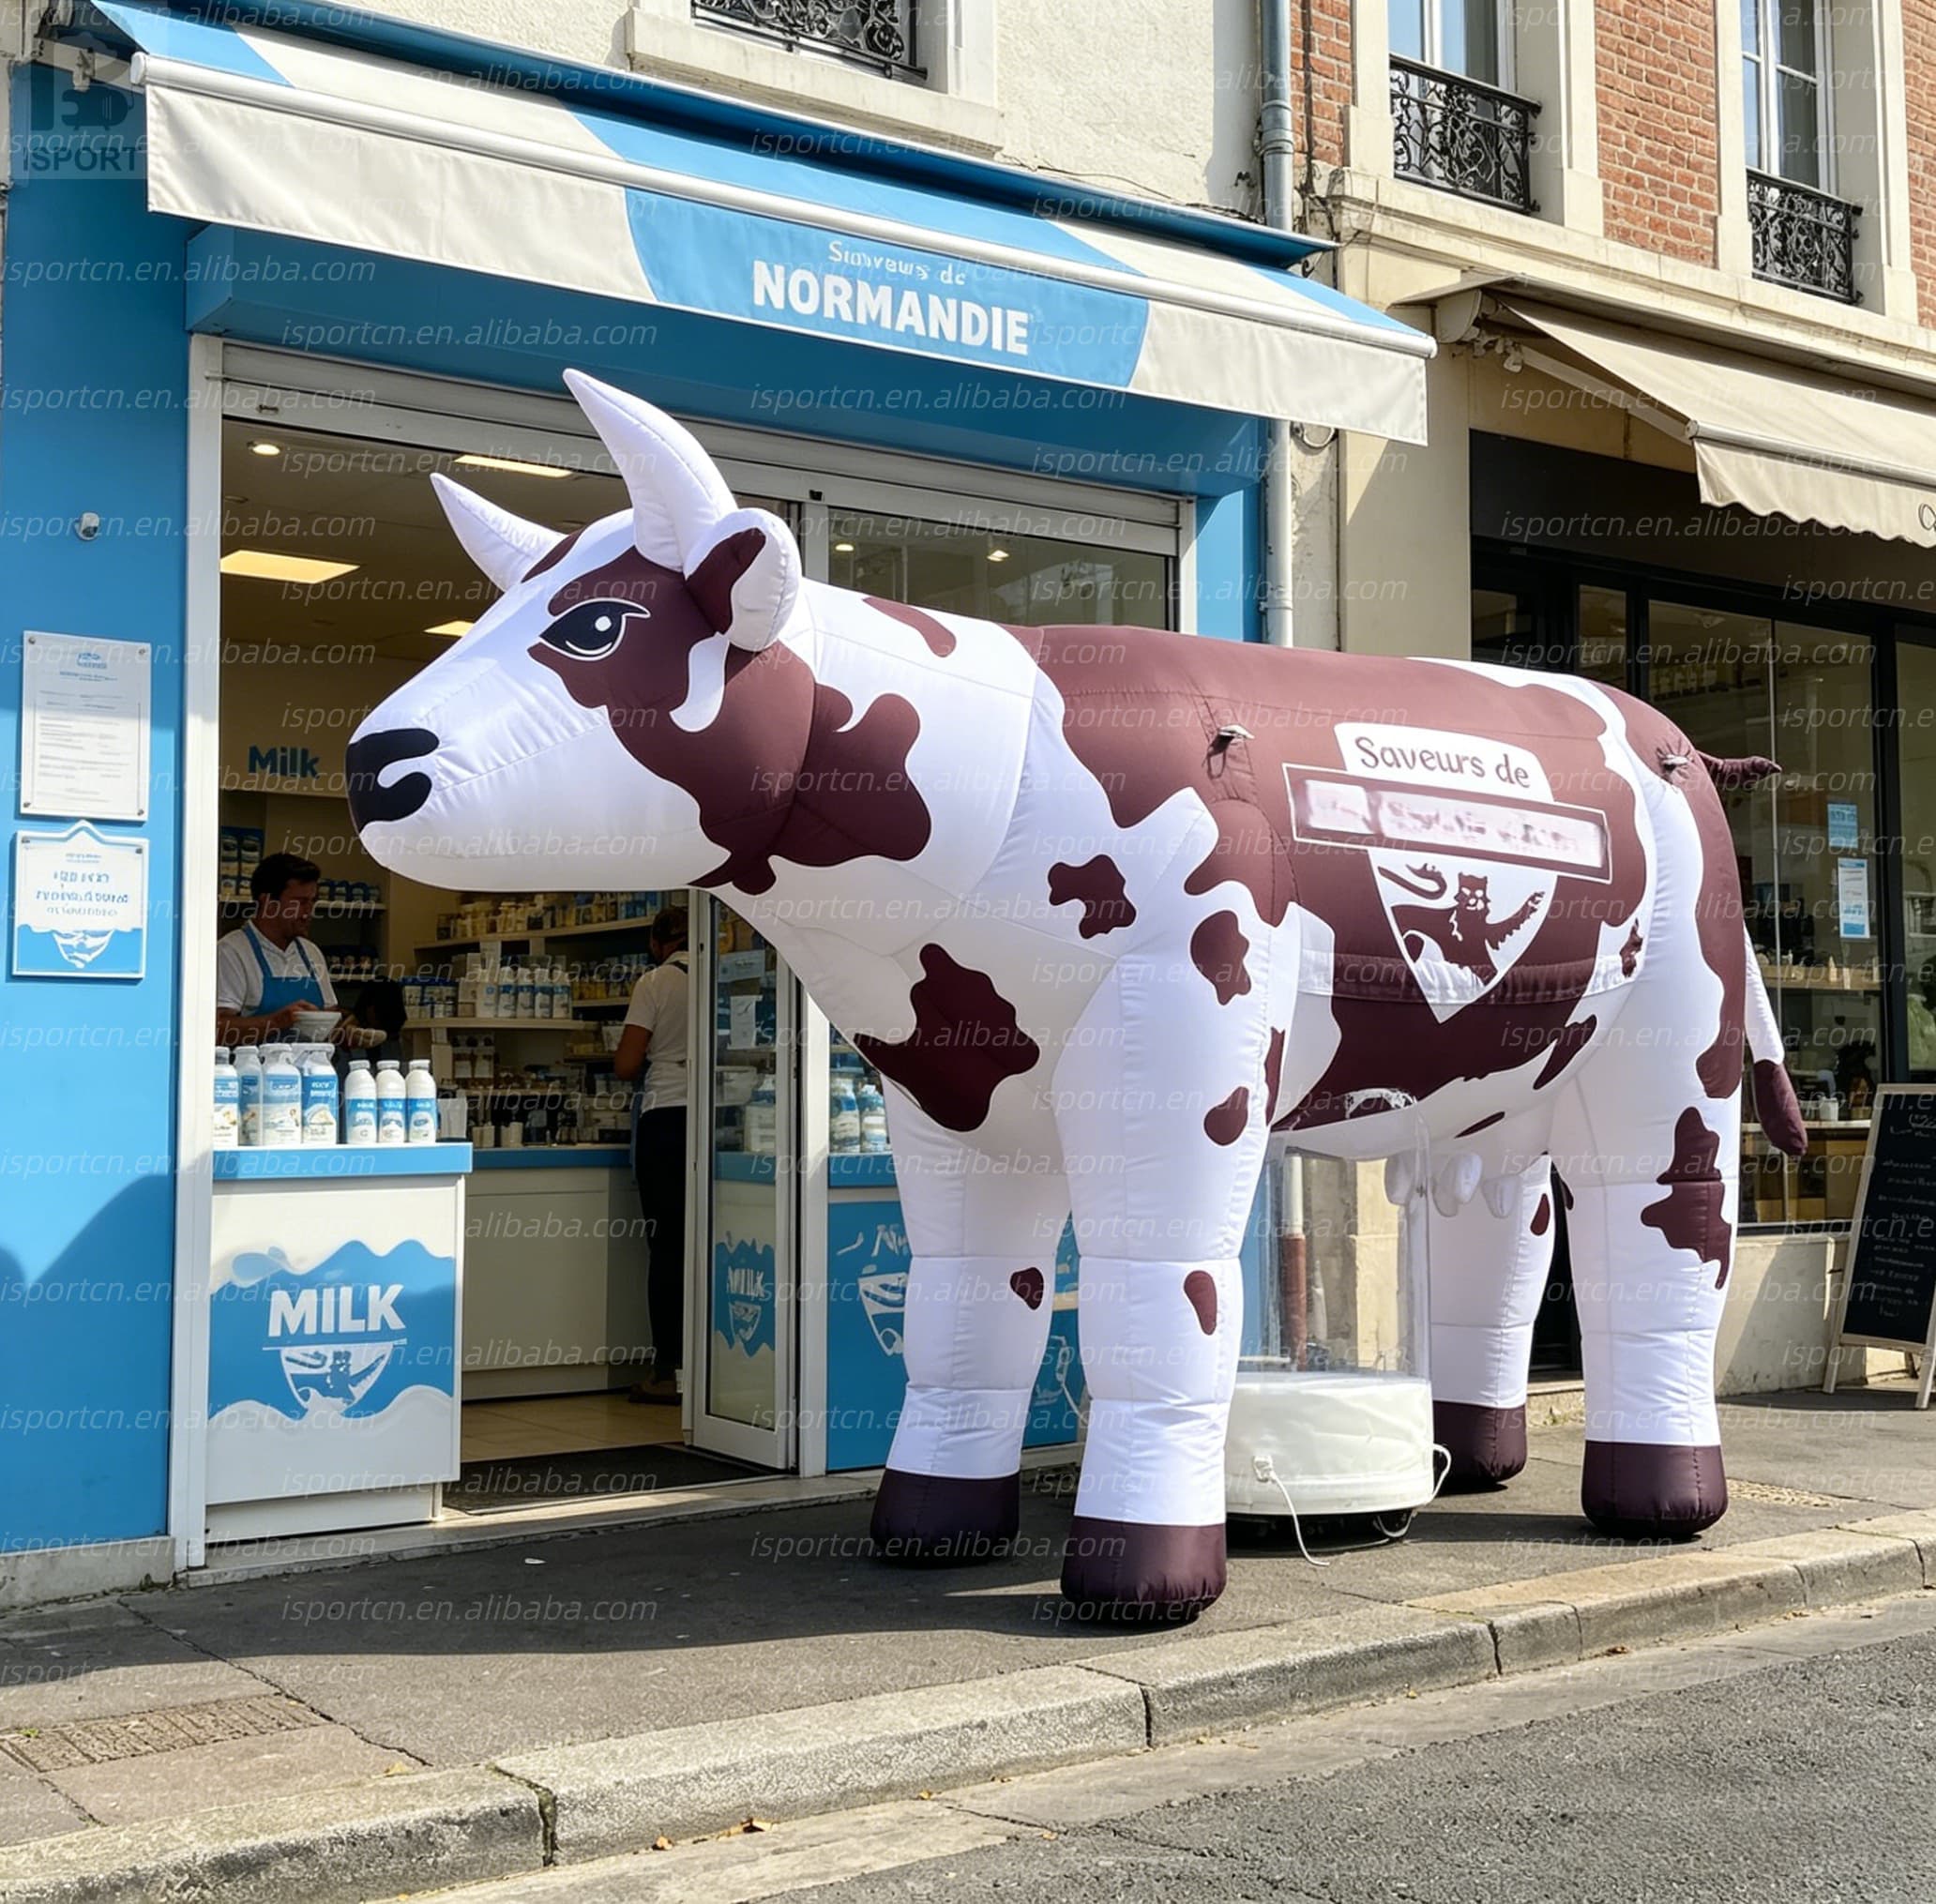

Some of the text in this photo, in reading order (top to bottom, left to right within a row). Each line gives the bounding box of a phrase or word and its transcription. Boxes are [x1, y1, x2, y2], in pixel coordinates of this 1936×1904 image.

[753, 260, 1029, 355] NORMANDIE
[249, 744, 320, 779] Milk
[1354, 736, 1531, 788] Saveurs de
[268, 1284, 406, 1337] MILK
